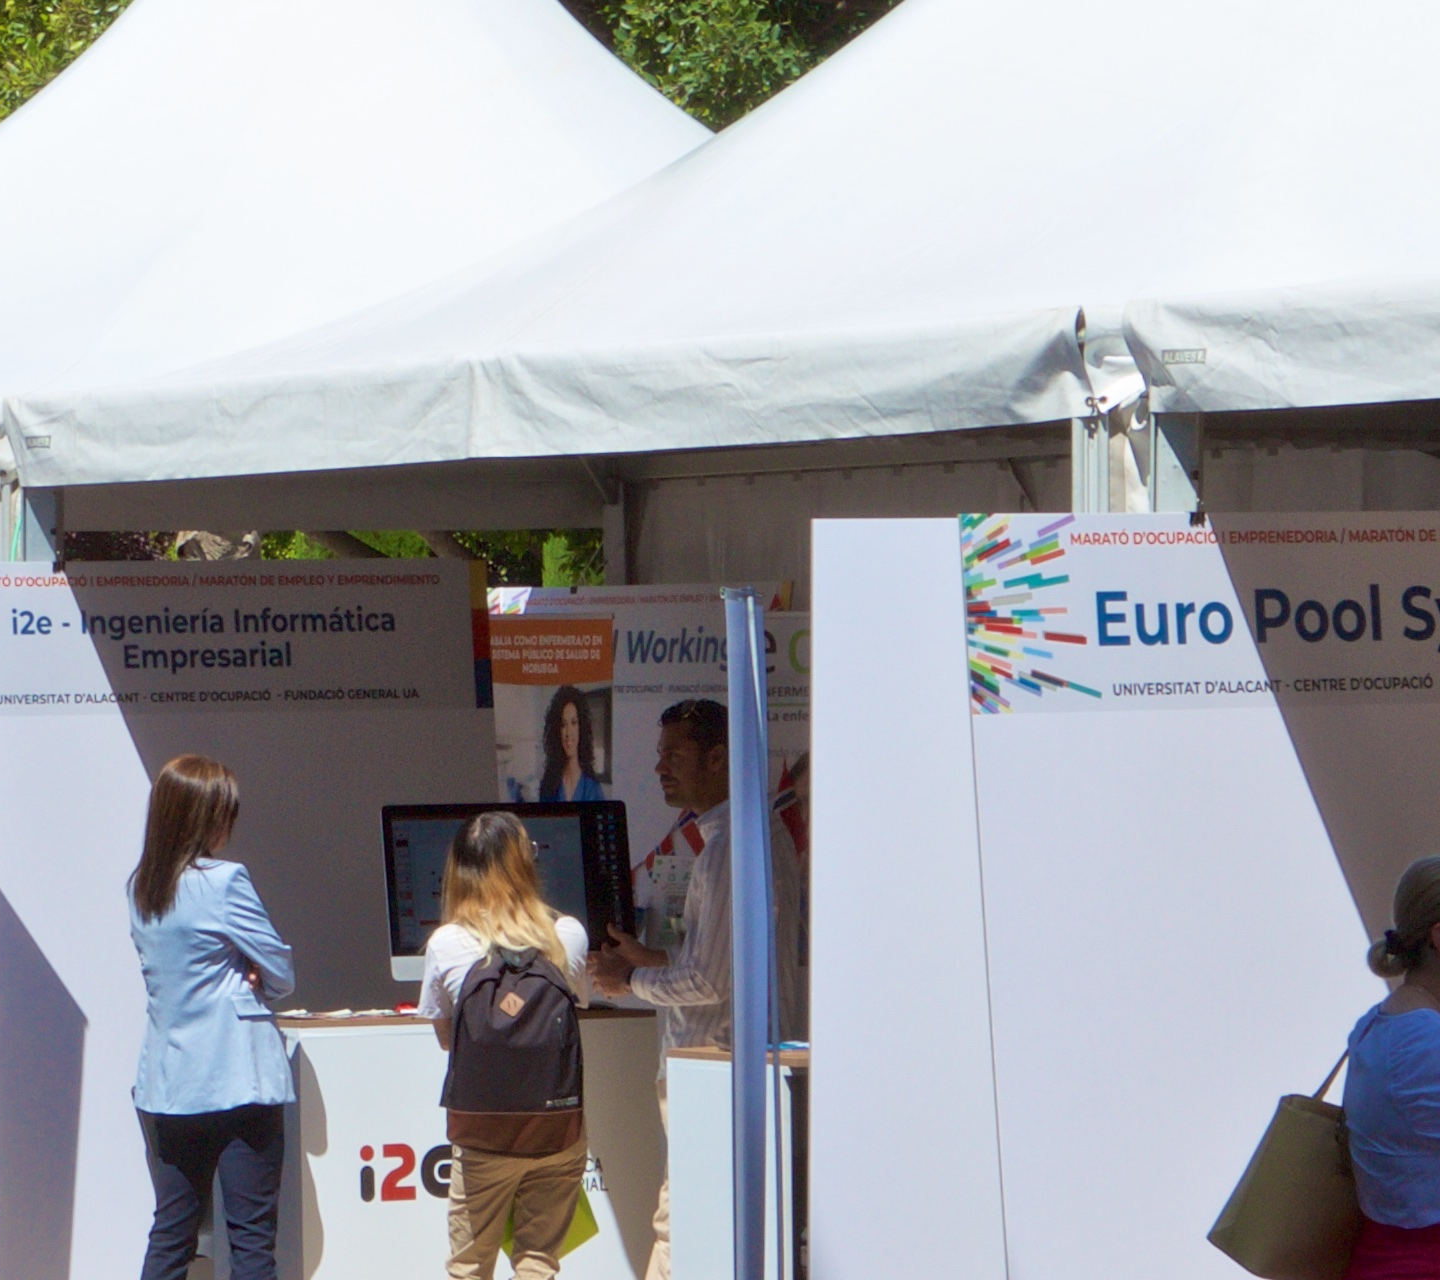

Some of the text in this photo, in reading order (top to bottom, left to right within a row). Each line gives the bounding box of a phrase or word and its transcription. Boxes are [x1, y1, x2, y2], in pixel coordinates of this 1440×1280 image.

[1070, 530, 1129, 545] MARATÓ
[1133, 529, 1217, 545] D'OCUPACIÓ
[1229, 529, 1339, 544] EMPRENEDORIA
[1348, 527, 1417, 543] MARATÓN
[1420, 528, 1437, 542] DE
[14, 575, 87, 587] D'OCUPACIÓ
[96, 575, 189, 587] EMPRENEDORIA
[199, 573, 257, 587] MARATÓN
[260, 574, 275, 586] DE
[278, 574, 325, 586] EMPLEO
[328, 574, 336, 586] Y
[337, 573, 440, 586] EMPRENDIMIENTO
[11, 605, 396, 641] i2e Ingeniería Informática
[1096, 590, 1234, 646] Euro
[1254, 582, 1383, 644] Pool
[123, 641, 292, 674] Empresarial
[74, 692, 140, 705] D'ALACANT
[150, 690, 196, 703] CENTRE
[199, 689, 271, 702] D'OCUPACIÓ
[284, 687, 345, 701] FUNDACIÓ
[347, 688, 400, 700] GENERAL
[403, 688, 420, 700] UA
[1112, 681, 1201, 697] UNIVERSITAT
[1204, 679, 1281, 695] D'ALACANT
[1294, 678, 1346, 693] CENTRE
[1350, 673, 1434, 691] D'OCUPACIÓ
